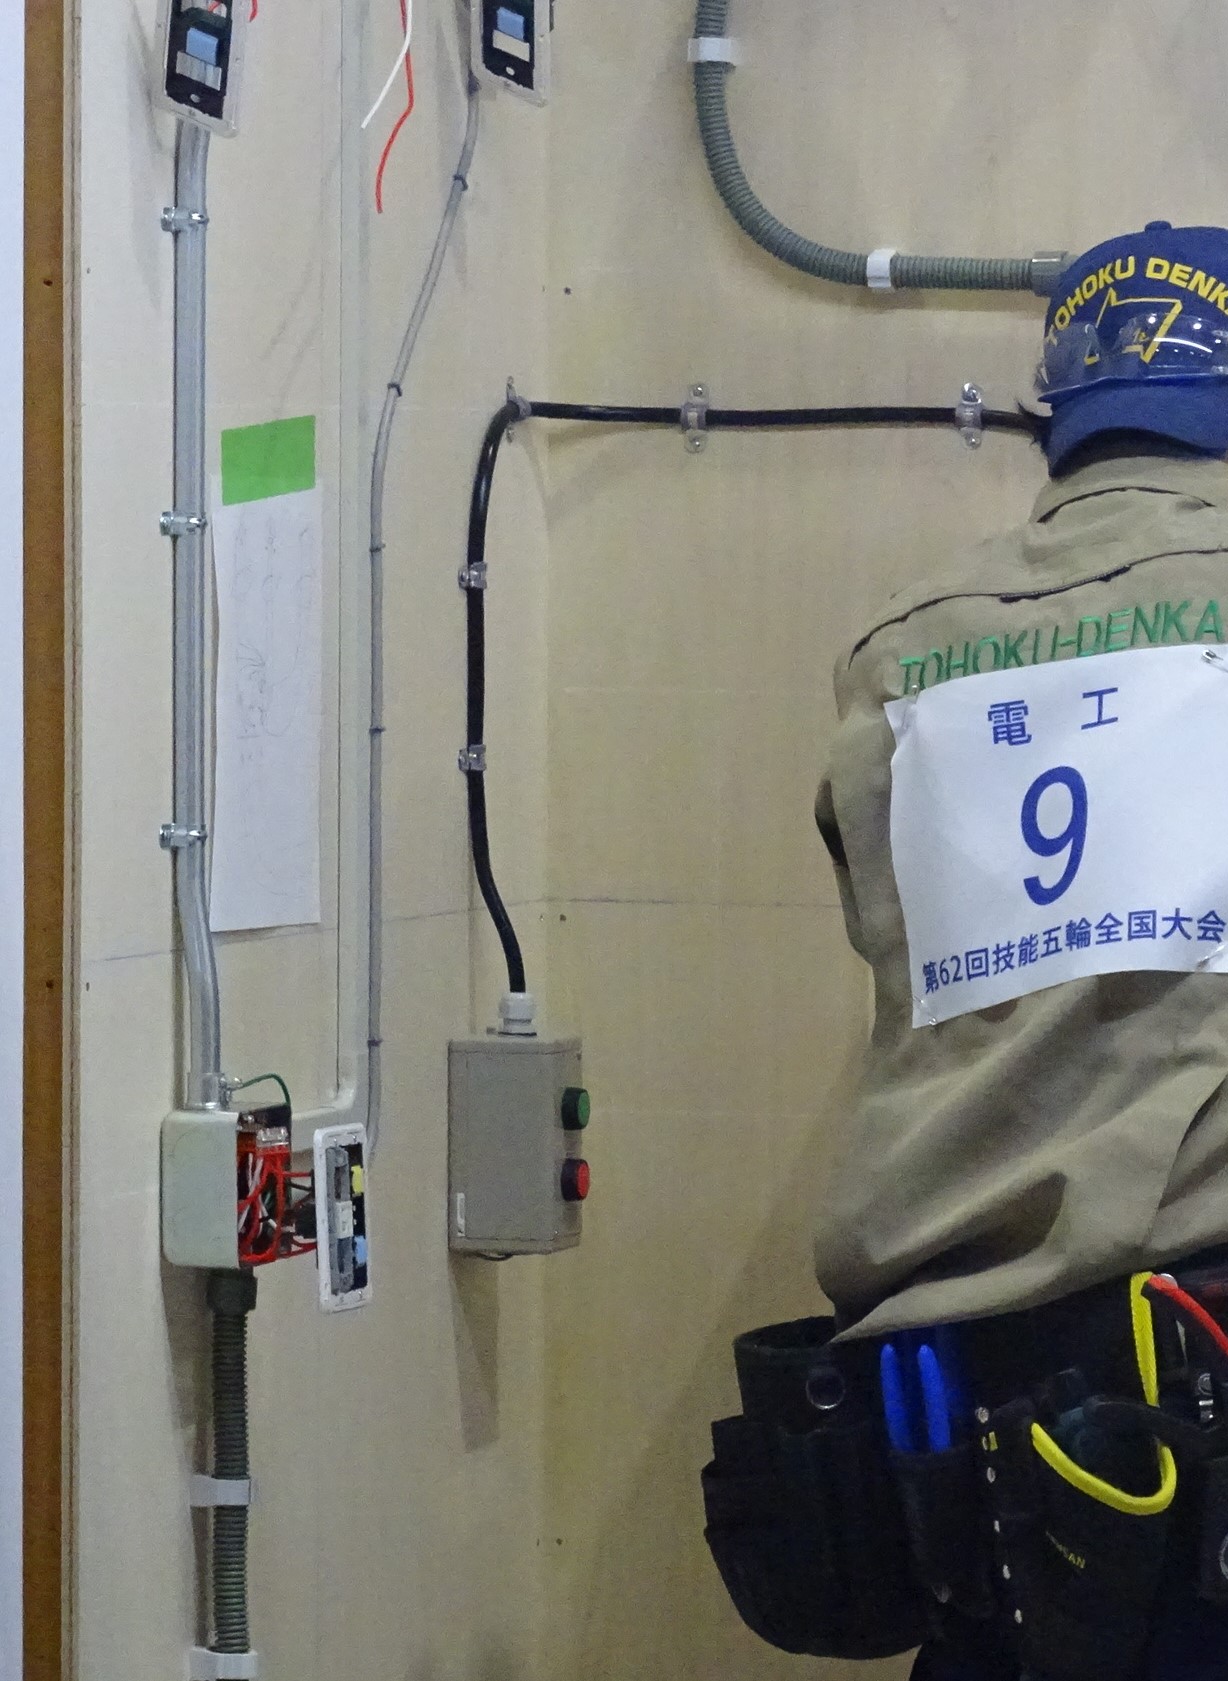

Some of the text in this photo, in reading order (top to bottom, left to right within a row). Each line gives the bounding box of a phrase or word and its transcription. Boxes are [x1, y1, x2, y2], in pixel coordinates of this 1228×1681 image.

[1045, 255, 1136, 347] TOHOKU
[899, 600, 1225, 695] TOHOKU-DENKA
[987, 687, 1119, 746] 電 工
[1021, 765, 1088, 906] 9
[922, 907, 1227, 994] 第62回技能五輪全国大会
